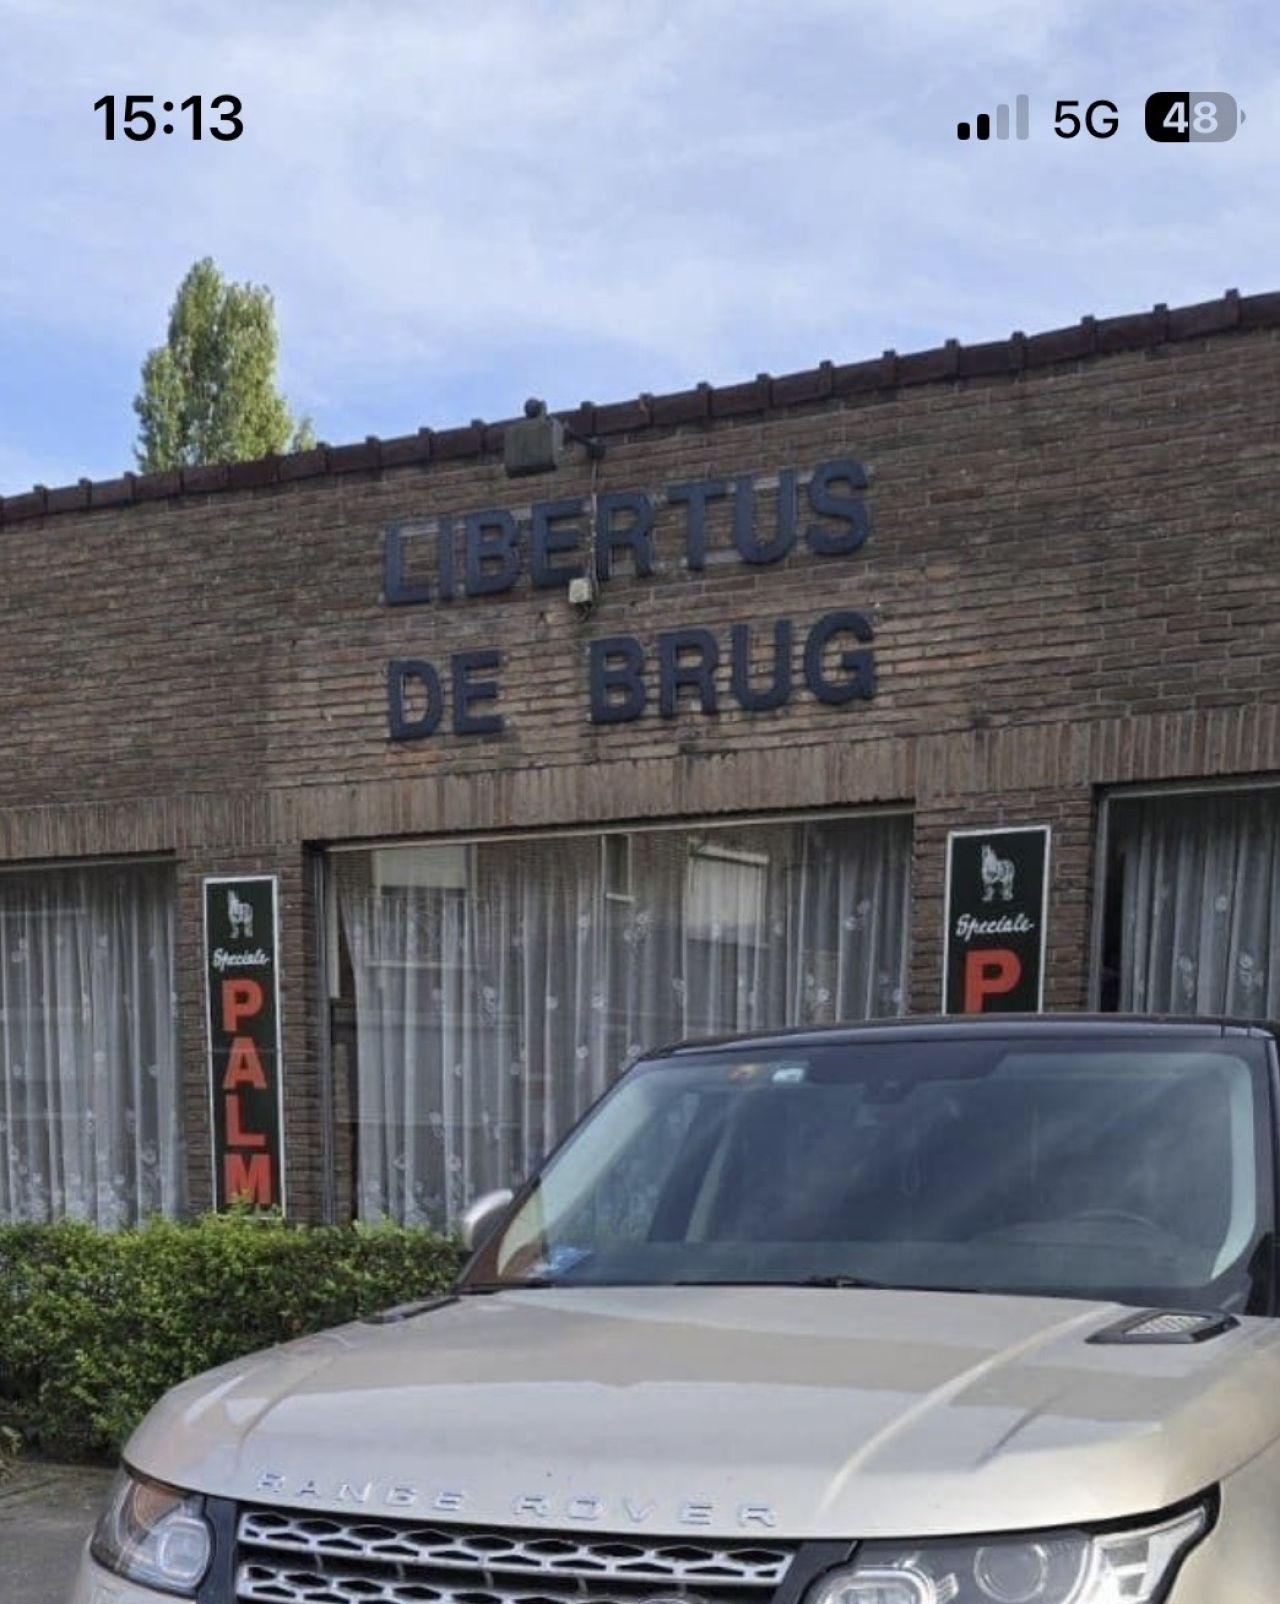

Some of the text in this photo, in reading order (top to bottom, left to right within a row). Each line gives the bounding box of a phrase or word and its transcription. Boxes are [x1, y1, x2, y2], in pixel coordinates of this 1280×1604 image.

[383, 458, 871, 607] LIBERTUS
[387, 610, 877, 742] DE BRUG
[221, 979, 272, 1206] PALM
[255, 1470, 777, 1528] RANGE ROVER
